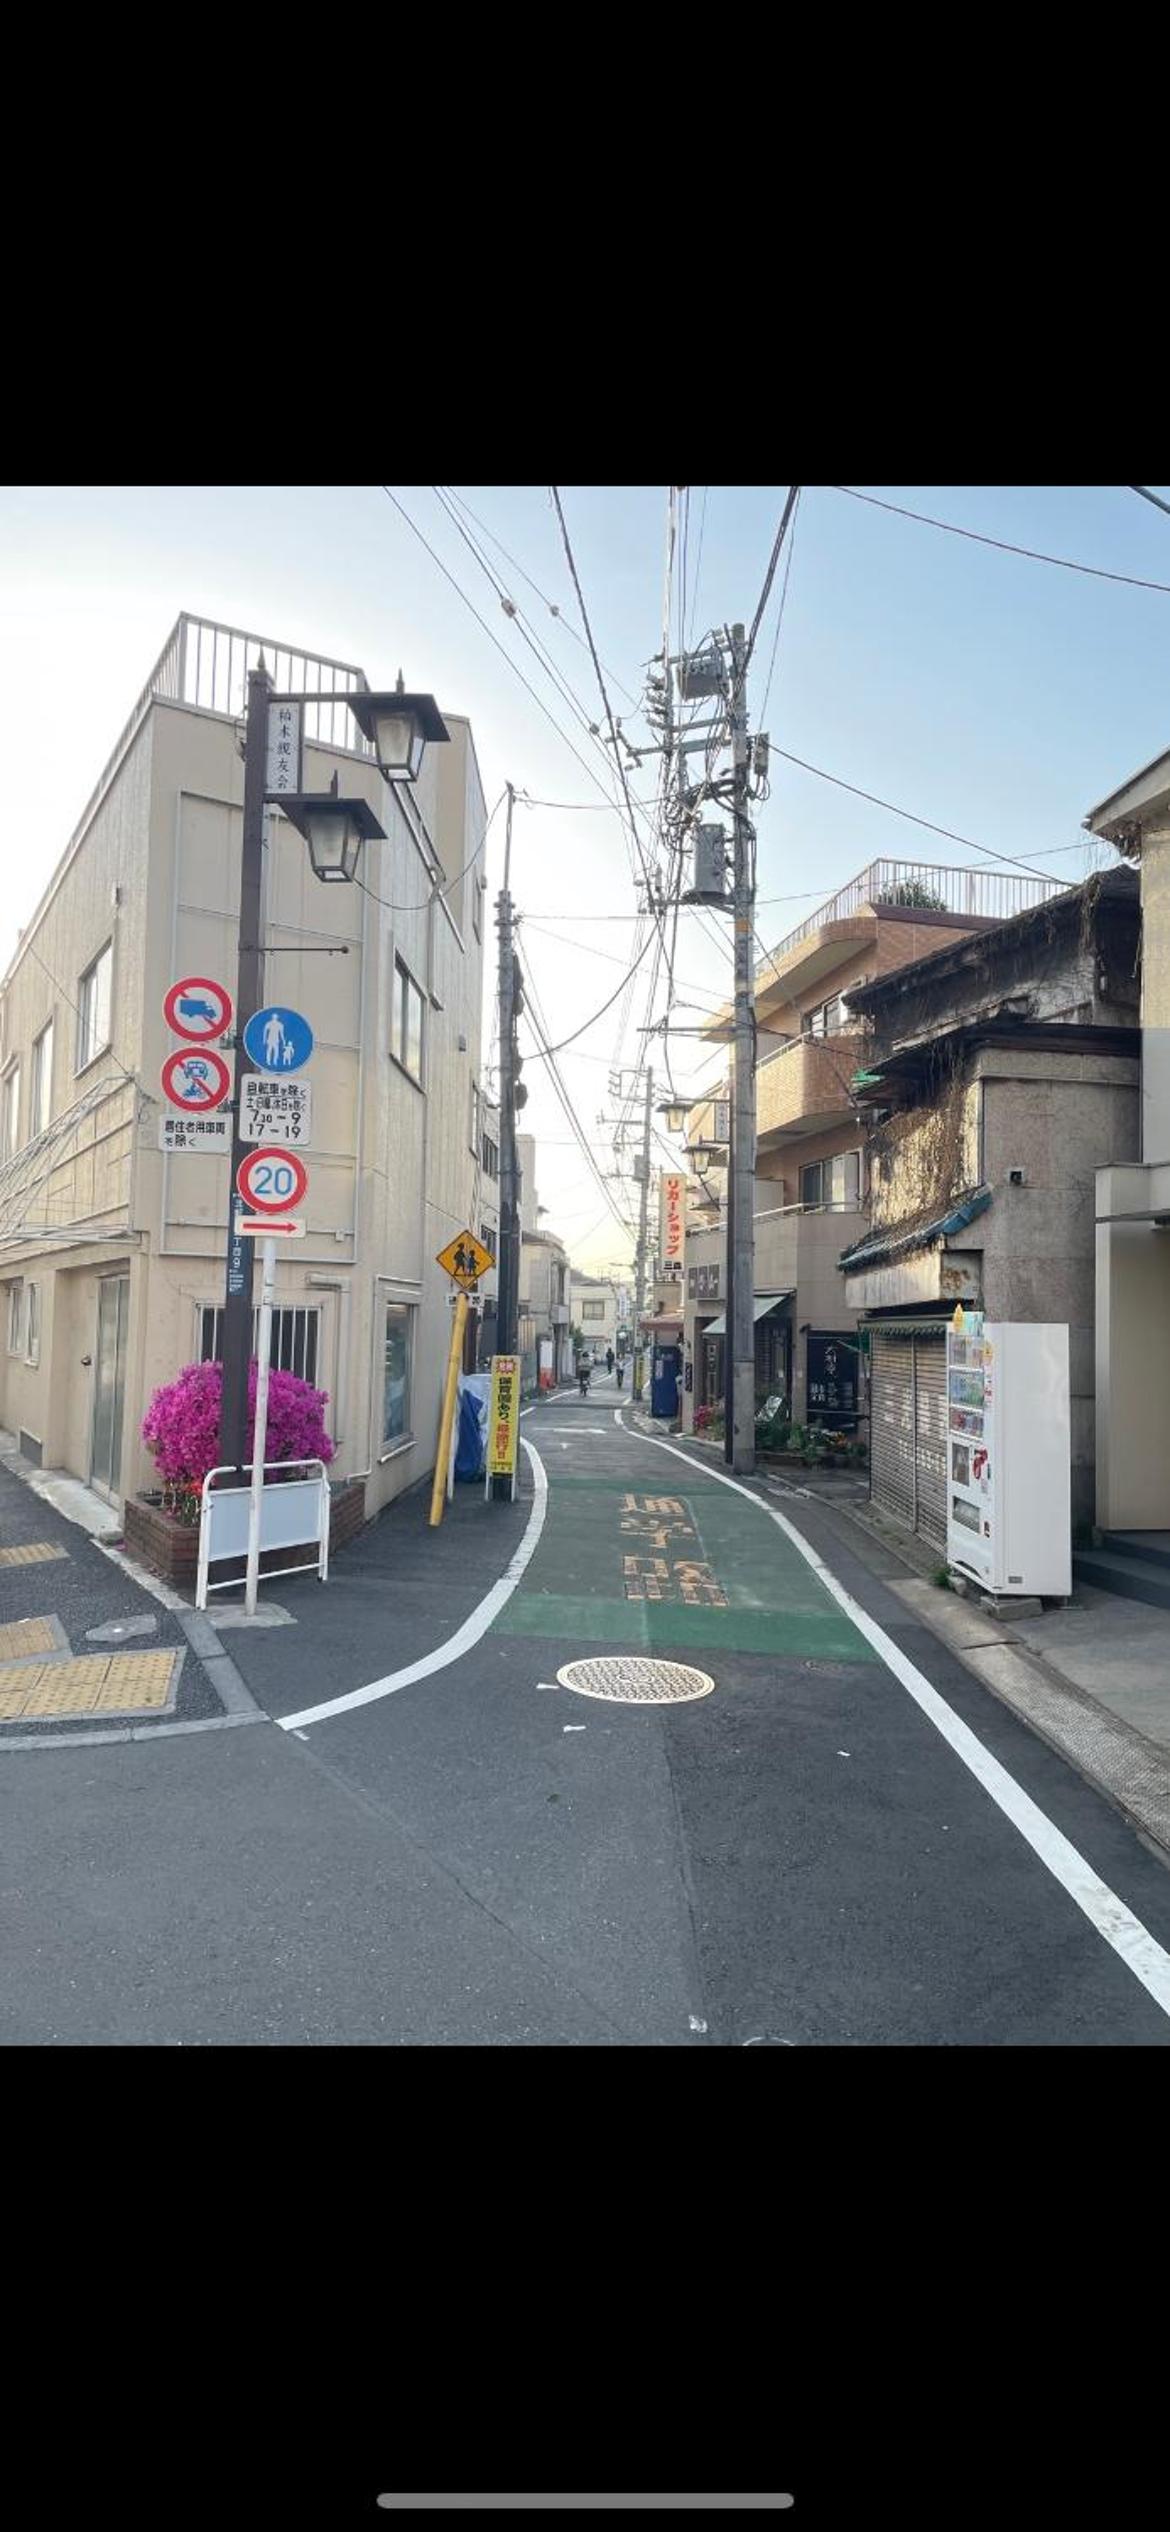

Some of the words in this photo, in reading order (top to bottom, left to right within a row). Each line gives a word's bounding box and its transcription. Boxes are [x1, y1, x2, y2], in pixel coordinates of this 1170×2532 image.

[254, 1166, 292, 1195] 20
[667, 1178, 680, 1255] リカーショップ
